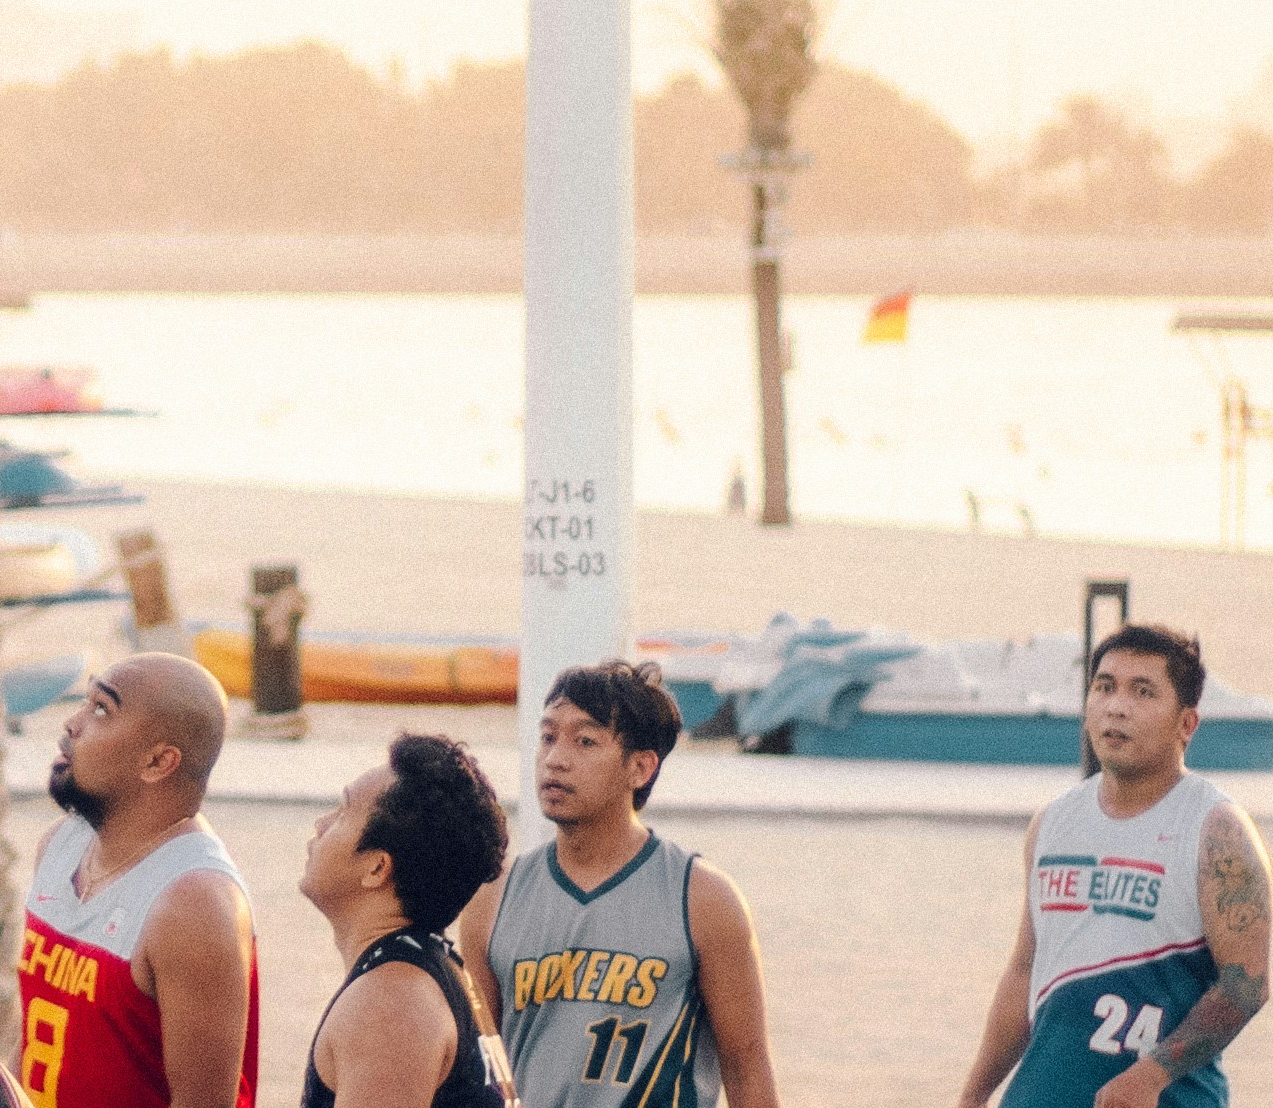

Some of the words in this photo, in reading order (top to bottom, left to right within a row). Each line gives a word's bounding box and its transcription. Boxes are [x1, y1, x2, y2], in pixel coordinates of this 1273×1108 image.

[1038, 869, 1081, 898] THE
[1087, 869, 1162, 908] ELITES
[584, 1014, 651, 1087] 11
[1089, 994, 1164, 1060] 24
